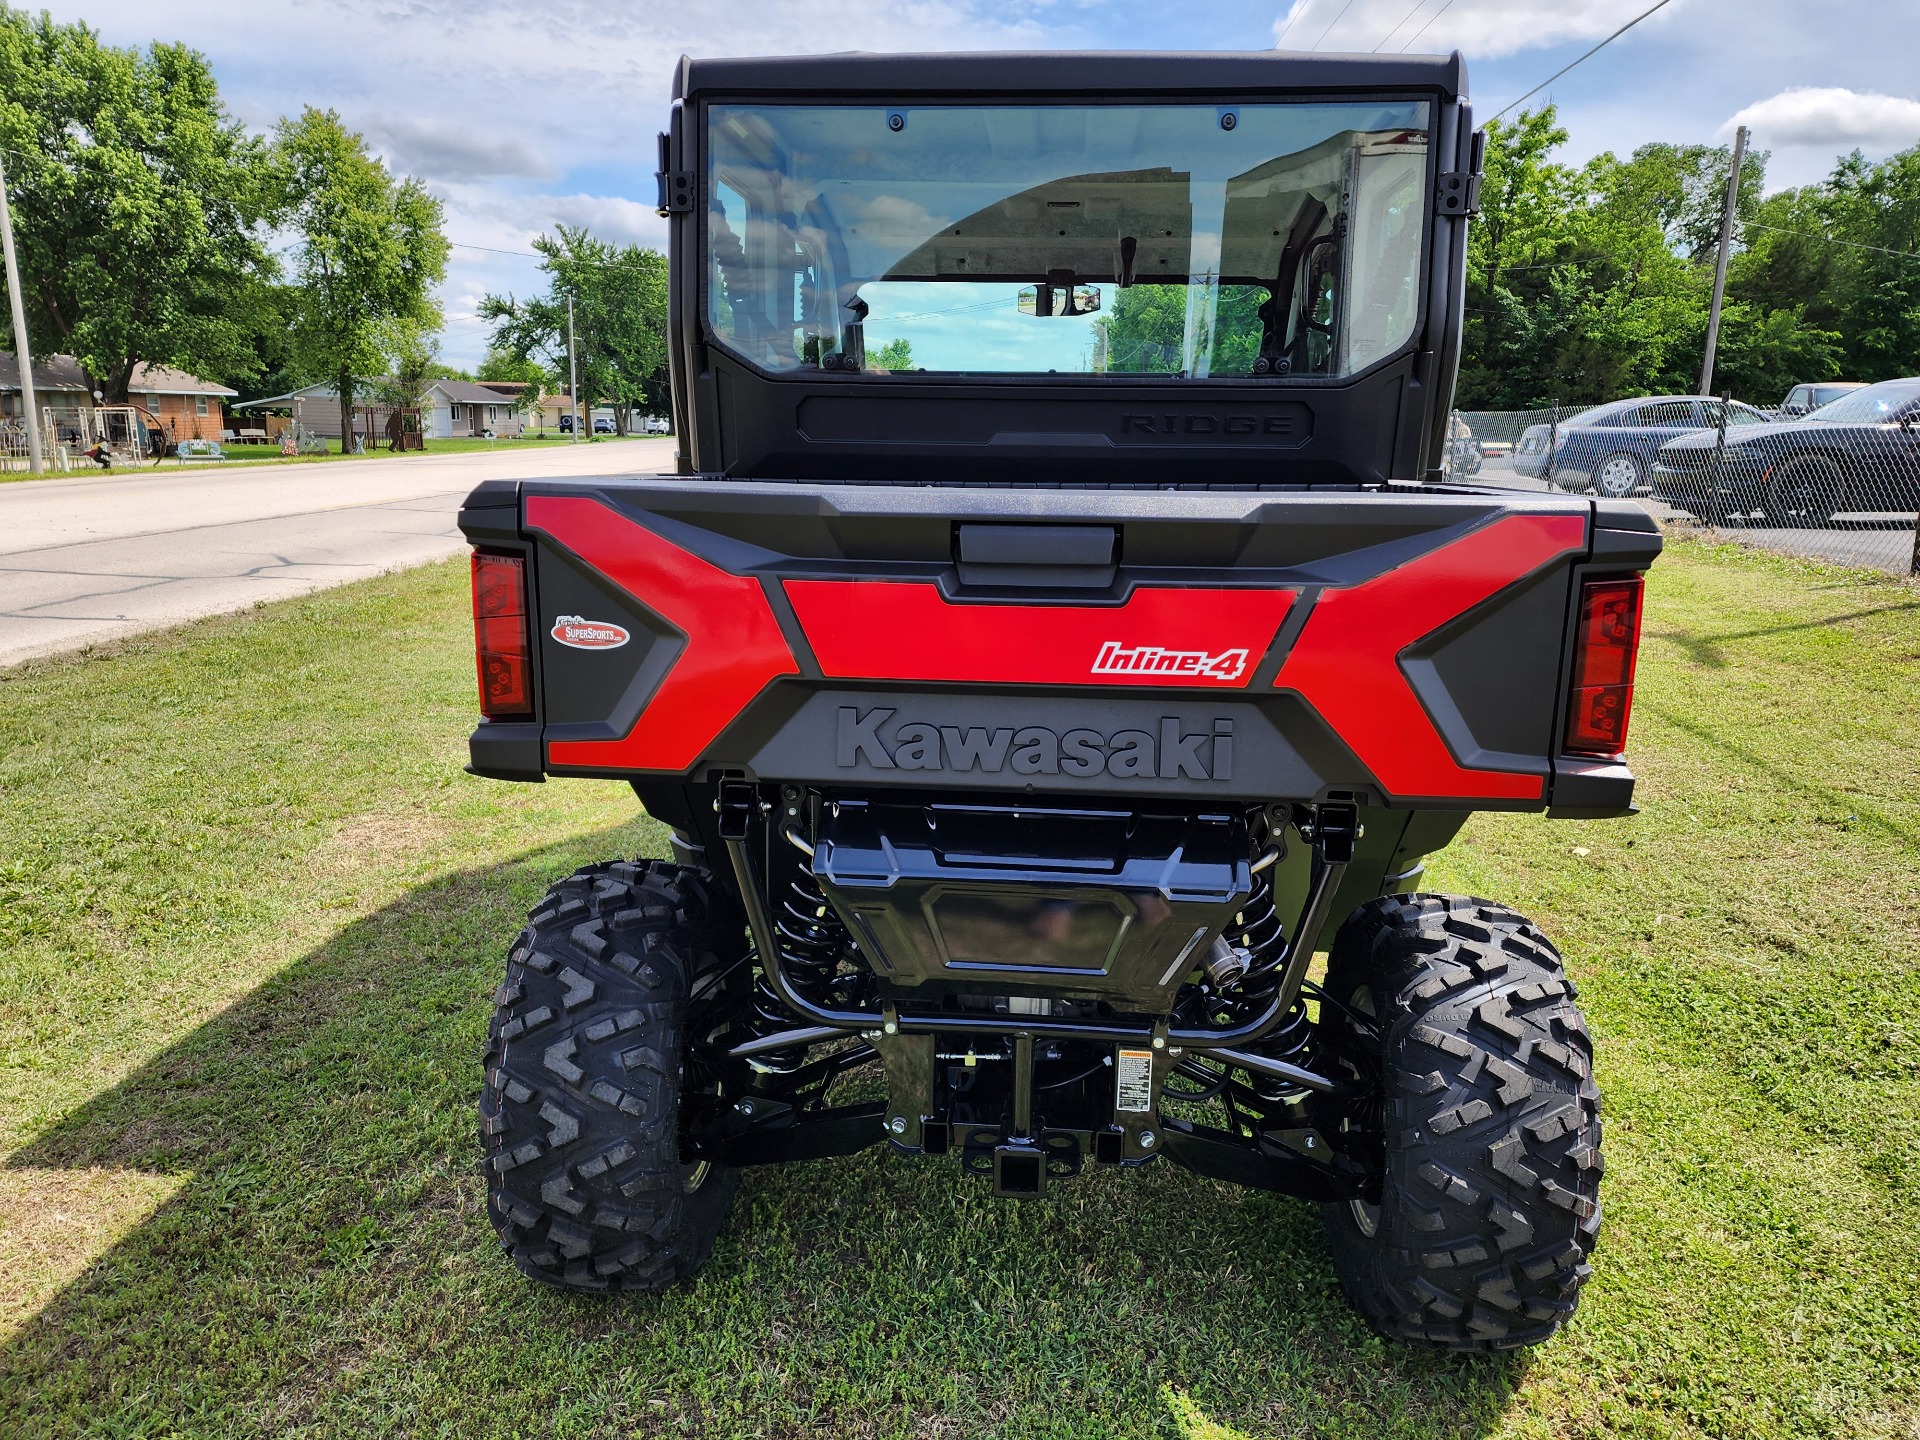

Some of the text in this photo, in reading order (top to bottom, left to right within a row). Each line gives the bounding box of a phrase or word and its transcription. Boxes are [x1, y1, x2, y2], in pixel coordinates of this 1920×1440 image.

[1121, 413, 1293, 435] RIDGE
[1090, 641, 1250, 680] Inline-4
[836, 705, 1234, 781] Kawasaki
